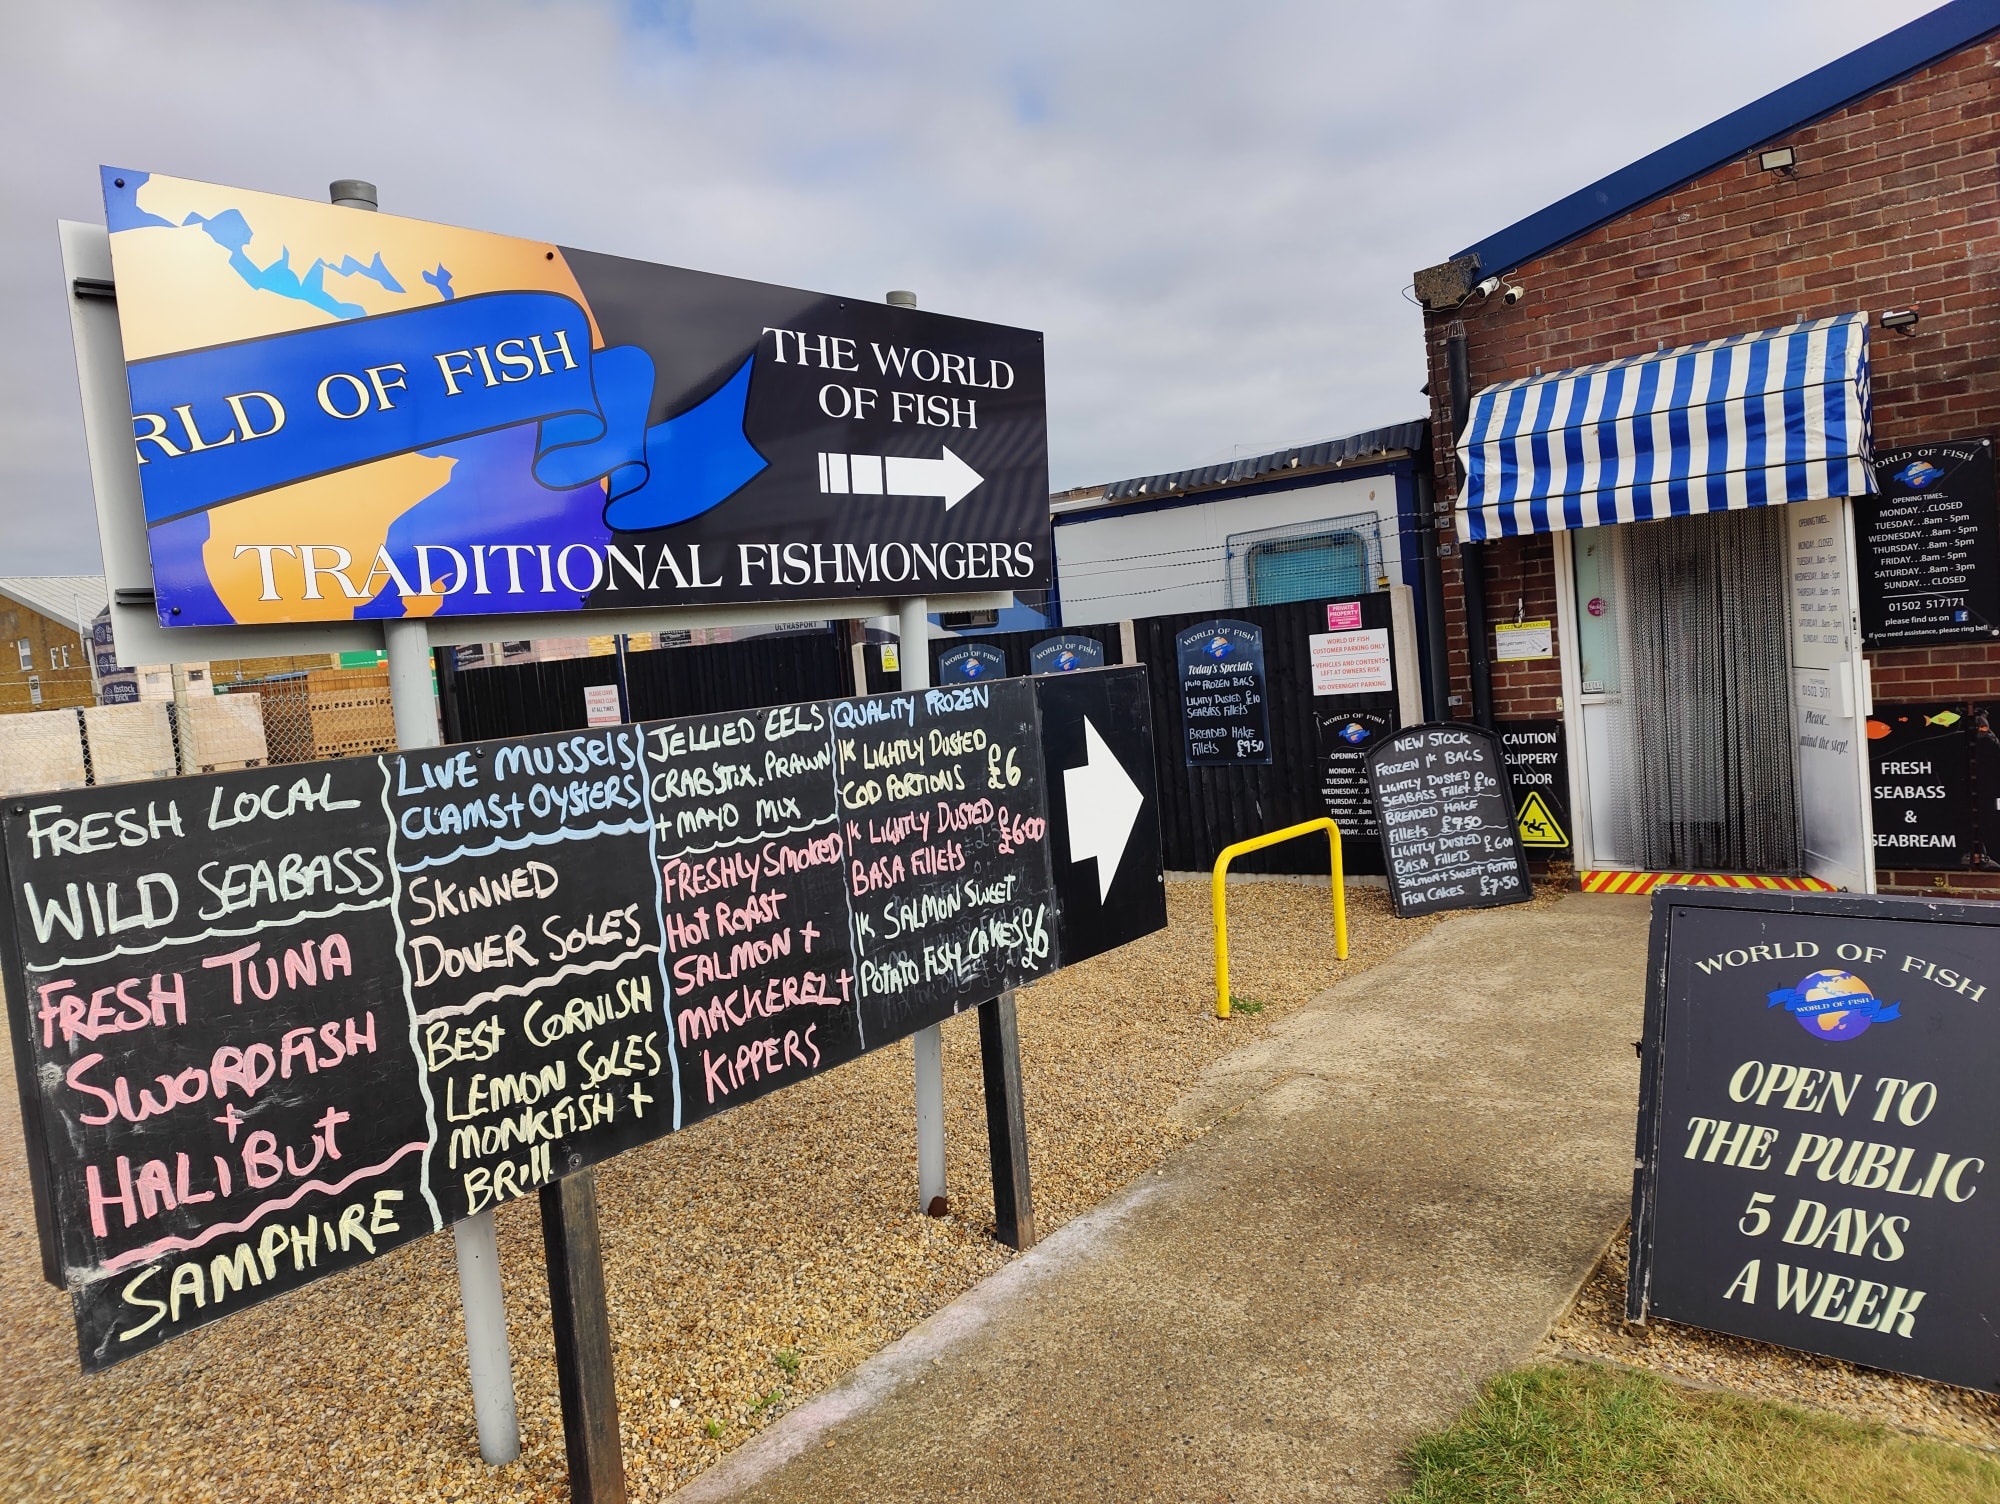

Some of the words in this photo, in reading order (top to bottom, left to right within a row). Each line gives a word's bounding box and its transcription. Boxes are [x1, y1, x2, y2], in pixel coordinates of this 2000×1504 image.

[761, 327, 860, 372] THE
[870, 342, 1015, 390] WORLD
[317, 363, 408, 420] OF
[434, 330, 578, 397] FISH
[819, 384, 879, 419] OF
[891, 391, 978, 430] FISH
[1875, 451, 1912, 469] ORLD
[1918, 448, 1937, 457] OF
[1942, 449, 1975, 462] FISH
[1892, 494, 1922, 504] OPENING
[1949, 513, 1970, 524] 5pm
[1957, 525, 1978, 536] 5pm
[1954, 538, 1975, 549] 5pm
[1947, 551, 1967, 562] 5pm
[233, 542, 723, 602] TRADITIONAL
[738, 541, 1035, 587] FISHMONGERS
[1955, 562, 1976, 573] 3pm
[1888, 600, 1921, 612] 01502
[1925, 597, 1965, 609] 517171
[774, 620, 818, 632] ULTRASPORT
[1885, 617, 1909, 626] please
[1911, 615, 1926, 624] find
[1183, 628, 1215, 646] WORLD
[1233, 629, 1254, 642] FISH
[1884, 630, 1903, 638] need
[1939, 626, 1959, 635] please
[1961, 625, 1975, 634] ring
[944, 652, 969, 667] WORLD
[971, 650, 981, 658] OF
[983, 651, 1000, 664] FISH
[1036, 643, 1063, 660] WORLD
[1078, 644, 1097, 657] FISH
[1313, 647, 1343, 655] CUSTOMER
[1219, 661, 1254, 675] Specials
[1356, 658, 1386, 666] CONTENTS
[1327, 682, 1360, 690] OVERNIGHT
[834, 696, 915, 729] QUALITY
[925, 685, 989, 716] FROZEN
[1186, 706, 1222, 719] SEABASS
[764, 704, 825, 741] EELS
[1323, 713, 1350, 727] WORLD
[1366, 713, 1385, 725] FISH
[1189, 727, 1227, 740] BREADED
[1231, 725, 1256, 739] HAKE
[1394, 735, 1424, 752] NEW
[1428, 732, 1472, 747] STOCK
[1502, 732, 1557, 745] CAUTION
[764, 742, 832, 781] PRAWN
[1330, 752, 1358, 760] OPENING
[1504, 752, 1558, 765] SLIPPERY
[397, 751, 479, 796] LIVE
[1375, 758, 1419, 777] FROZEN
[1881, 761, 1932, 775] FRESH
[842, 780, 882, 809] COD
[886, 764, 966, 801] PORTIONS
[1379, 777, 1421, 795] LIGHTLY
[1474, 771, 1497, 793] £10
[1513, 773, 1553, 785] FLOOR
[1381, 789, 1438, 807] SEABASS
[1874, 785, 1946, 799] SEABASS
[27, 799, 186, 859] FRESH
[208, 773, 362, 830] LOCAL
[677, 803, 739, 838] MAYO
[1385, 806, 1438, 826] BREADED
[1443, 799, 1479, 813] HAKE
[1904, 810, 1918, 823] &
[1390, 843, 1435, 858] LIGHTLY
[1872, 834, 1956, 848] SEABREAM
[852, 855, 905, 896] BASA
[1394, 859, 1429, 875] BASA
[663, 852, 760, 904] FRESHLY
[24, 872, 180, 943] WILD
[198, 848, 384, 921] SEABASS
[1401, 891, 1426, 906] FISH
[1427, 885, 1465, 900] CAKES
[884, 884, 961, 939] SALMON
[964, 874, 1016, 907] SWEET
[408, 924, 540, 987] DOVER
[542, 903, 641, 961] SOLES
[673, 928, 791, 996] SALMON
[860, 960, 919, 997] POTATO
[924, 942, 962, 982] FISH
[968, 916, 1024, 960] CAKES
[1695, 941, 1820, 977] WORLD
[1836, 943, 1887, 966] OF
[1899, 955, 1988, 1003] FISH
[37, 972, 187, 1048] FRESH
[202, 933, 353, 1004] TUNA
[523, 976, 654, 1047] CORNISH
[1796, 1004, 1830, 1013] WORLD
[1848, 997, 1870, 1006] FISH
[66, 1011, 378, 1126] SWORDFISH
[704, 1022, 820, 1104] KIPPERS
[446, 1061, 566, 1122] LEMON
[577, 1031, 662, 1090] SOLES
[1728, 1060, 1863, 1117] OPEN
[1872, 1076, 1938, 1127] TO
[449, 1092, 614, 1169] MONKFISH
[1683, 1116, 1779, 1172] THE
[1784, 1132, 1985, 1204] PUBLIC
[1738, 1191, 1777, 1238] 5
[1782, 1199, 1911, 1262] DAYS
[119, 1190, 404, 1342] SAMPHIRE
[1722, 1259, 1760, 1305] A
[1776, 1262, 1927, 1339] WEEK
